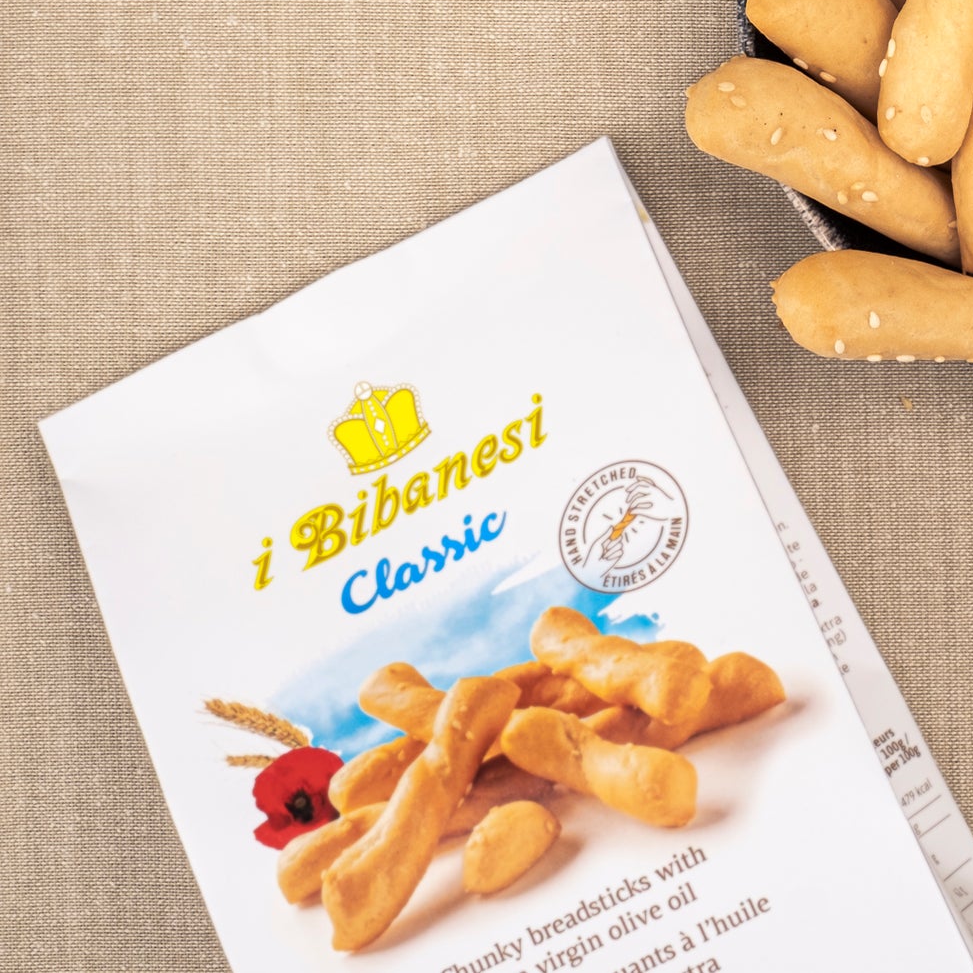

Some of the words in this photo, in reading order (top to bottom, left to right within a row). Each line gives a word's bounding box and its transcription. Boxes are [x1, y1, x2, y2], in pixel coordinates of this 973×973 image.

[251, 537, 274, 591] i
[289, 393, 548, 572] Bibanesi
[568, 467, 637, 522] STRETCHED
[340, 510, 507, 615] Classic
[565, 528, 583, 566] HAND
[655, 552, 671, 567] LA
[665, 517, 683, 550] MAIN
[898, 745, 922, 765] 100g
[915, 777, 933, 797] kcal
[526, 875, 652, 946] breadsticks
[654, 846, 708, 881] with
[535, 934, 604, 973] virgin
[607, 904, 664, 941] olive
[668, 881, 698, 911] oil
[678, 930, 697, 952] à
